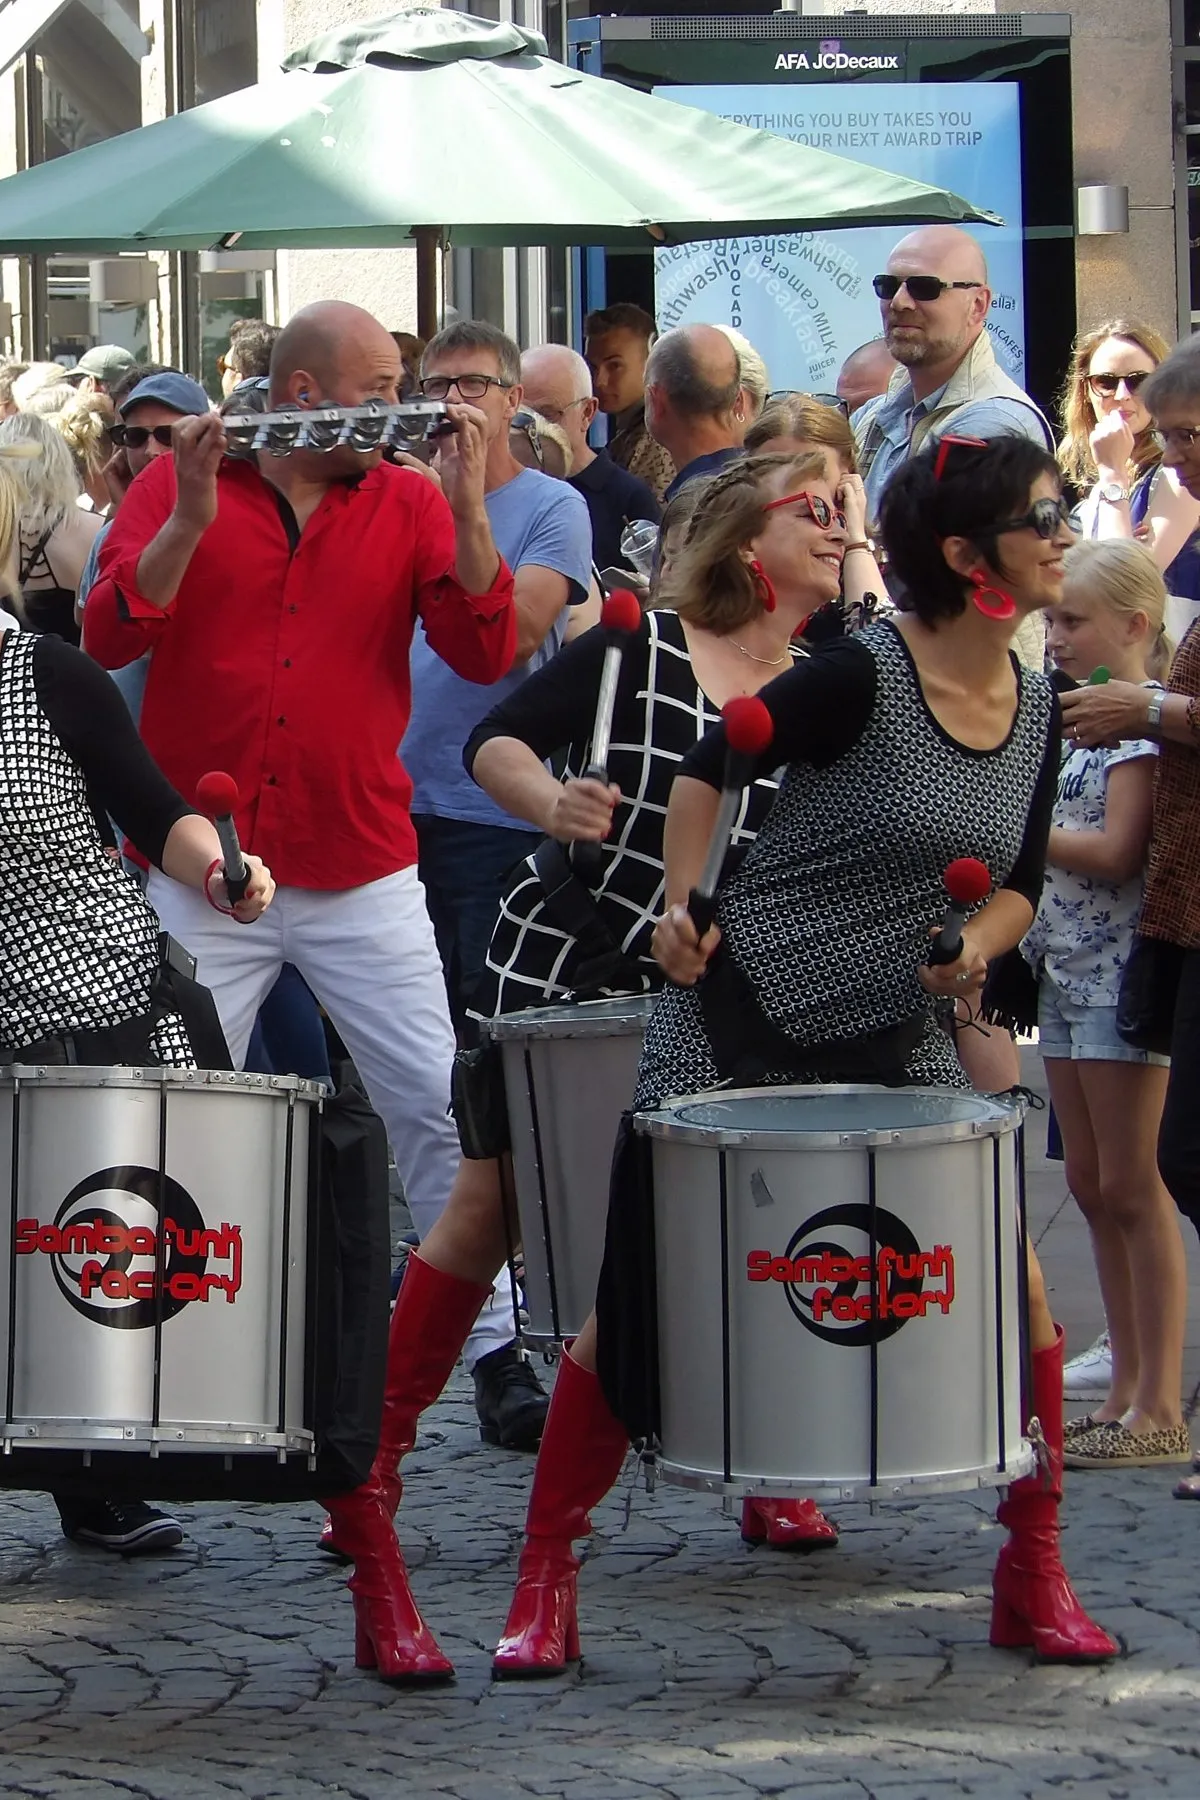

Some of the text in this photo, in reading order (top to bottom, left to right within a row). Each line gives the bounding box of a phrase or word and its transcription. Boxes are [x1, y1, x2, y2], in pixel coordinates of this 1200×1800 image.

[774, 53, 898, 70] AFA JCDecaux
[809, 113, 843, 128] YOU
[848, 113, 879, 128] BUY
[883, 112, 935, 127] TAKES
[938, 111, 972, 127] YOU
[837, 132, 880, 147] NEXT
[883, 132, 942, 147] AWARD
[945, 131, 983, 146] TRIP
[655, 239, 727, 275] Restau
[742, 238, 853, 291] Dishwasher
[729, 238, 742, 328] AVOCAD
[761, 254, 819, 310] camera
[812, 312, 839, 354] MILK
[997, 329, 1023, 359] CAFES
[808, 357, 837, 375] JUICER
[810, 371, 826, 382] taxi
[747, 1245, 955, 1284] Sambafunk
[812, 1287, 954, 1322] factory
